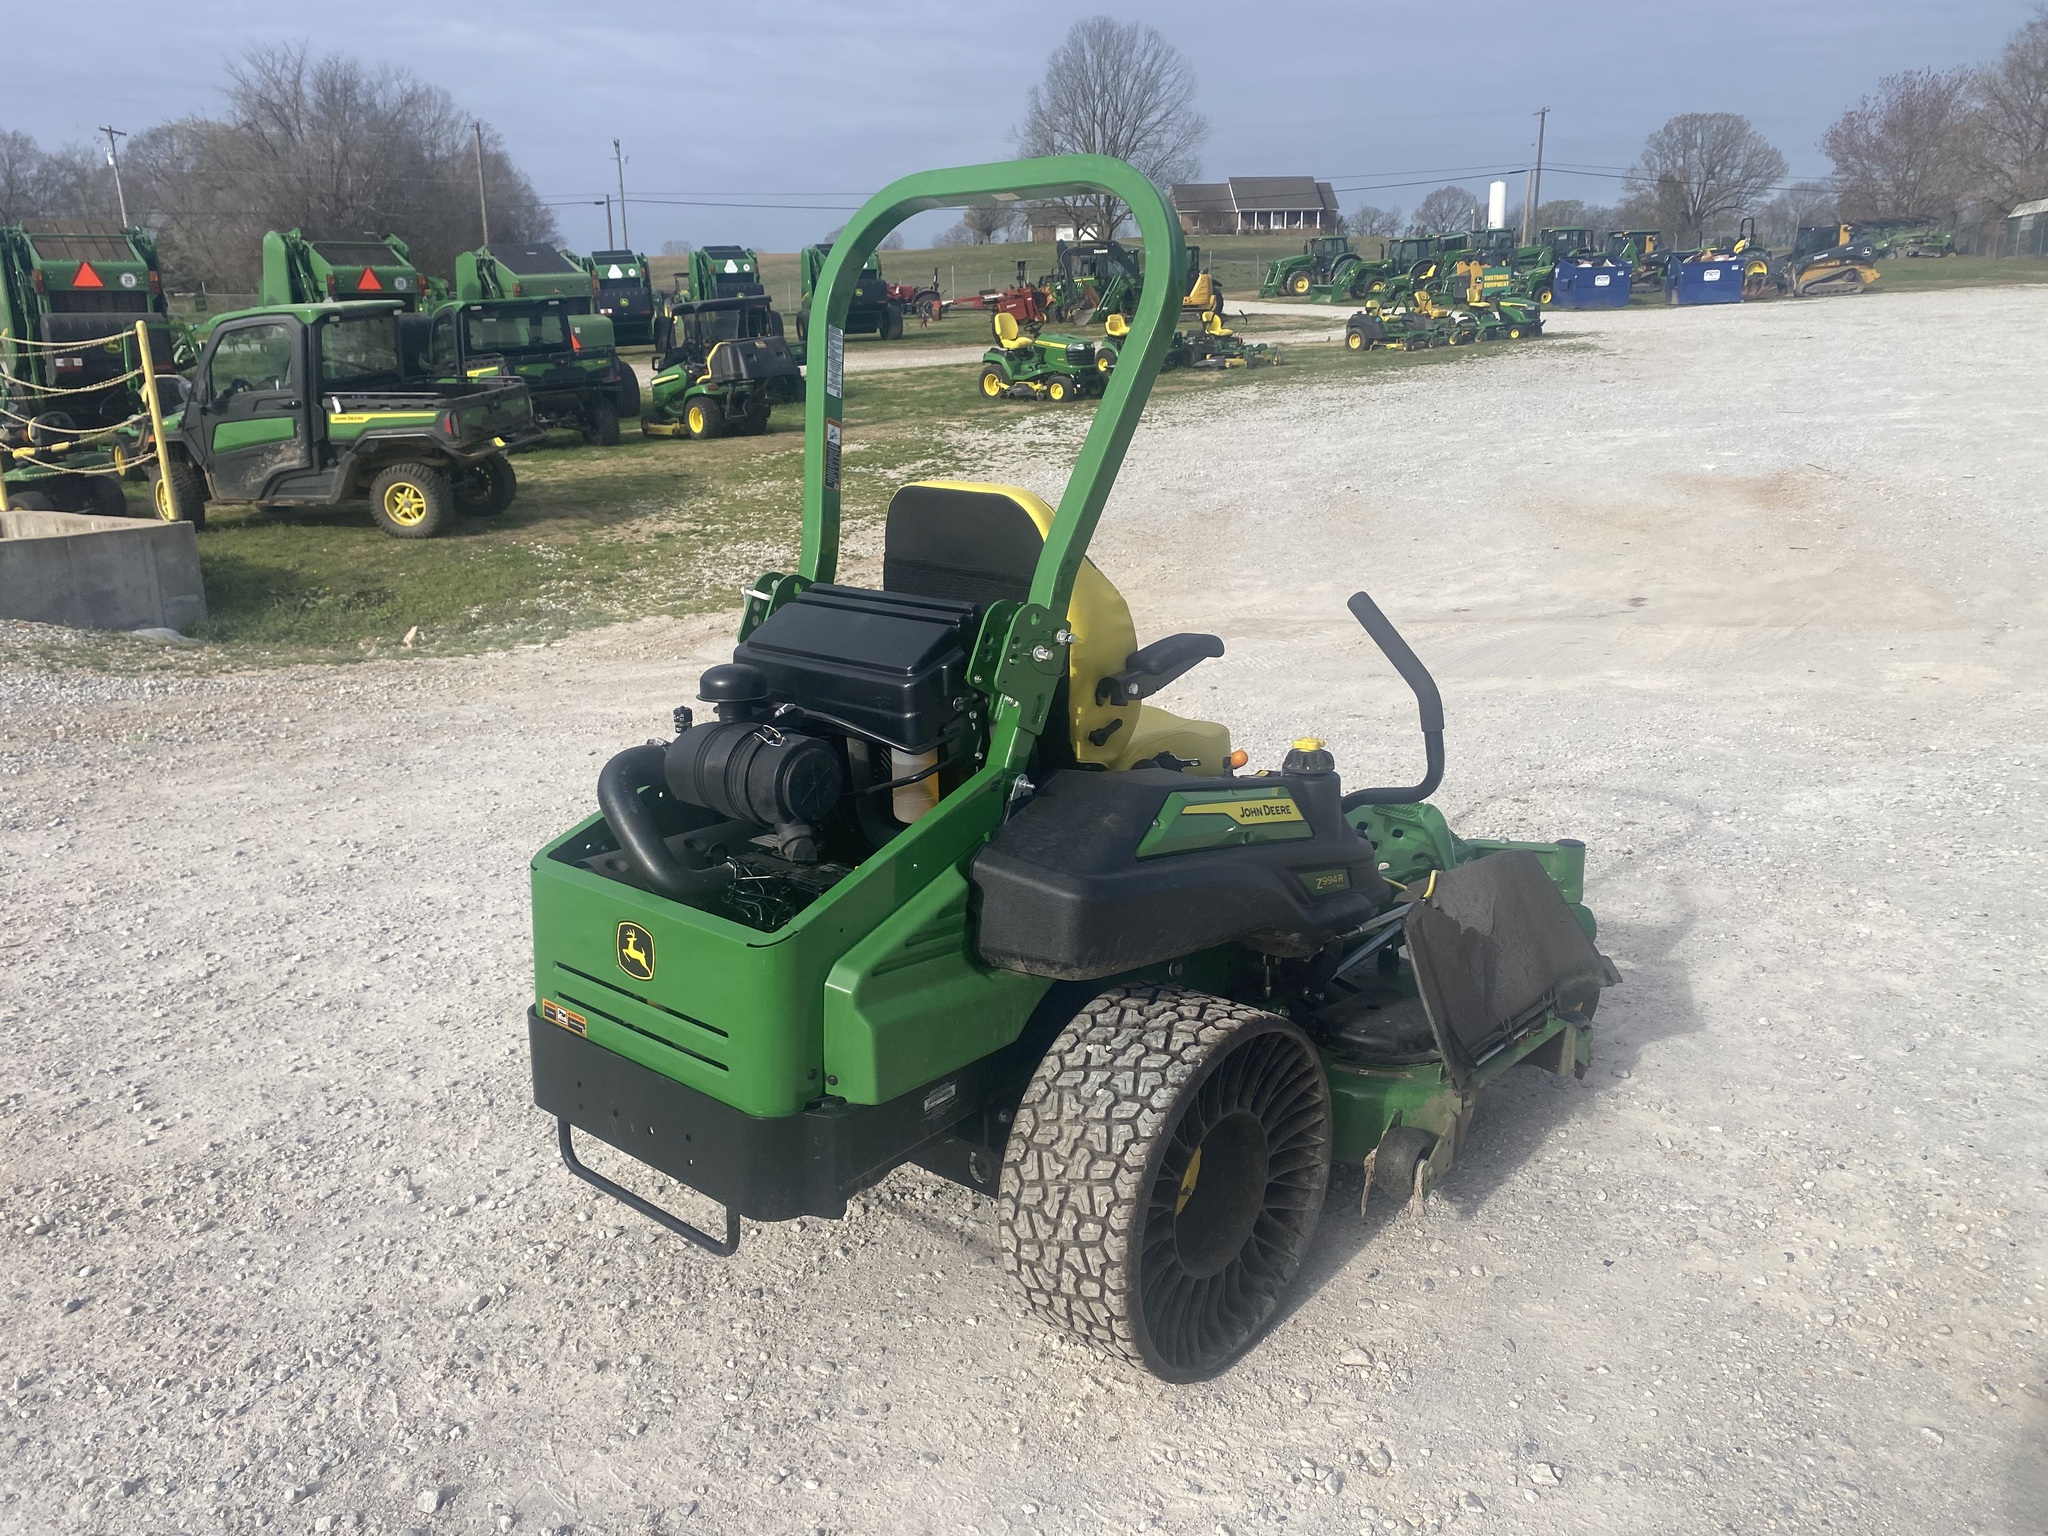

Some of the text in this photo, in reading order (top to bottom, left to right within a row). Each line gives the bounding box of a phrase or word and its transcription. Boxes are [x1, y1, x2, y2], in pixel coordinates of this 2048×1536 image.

[1240, 804, 1292, 818] JOHN DEERE
[1316, 873, 1344, 890] Z994R
